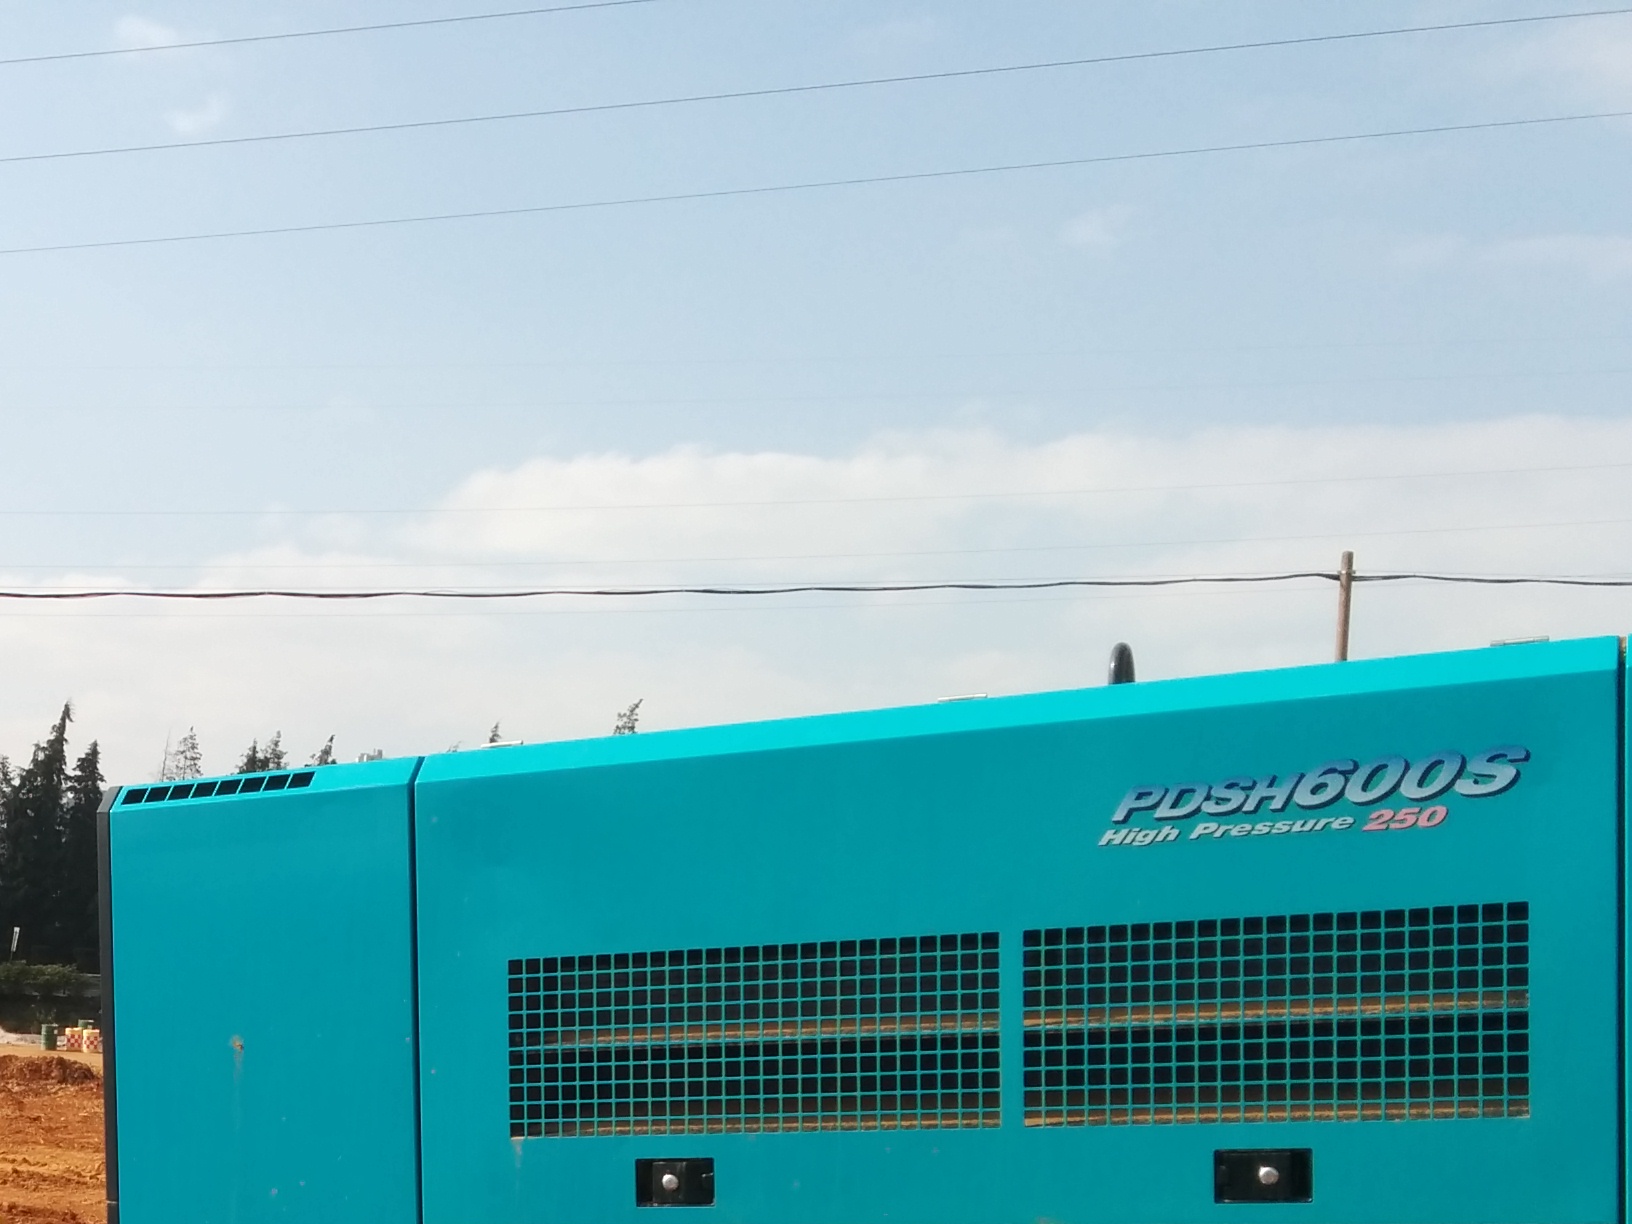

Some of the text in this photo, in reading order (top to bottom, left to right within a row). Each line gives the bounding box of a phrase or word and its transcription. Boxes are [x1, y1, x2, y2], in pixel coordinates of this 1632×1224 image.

[1112, 746, 1531, 823] PDSH600S
[1098, 805, 1448, 847] High Pressure 250
